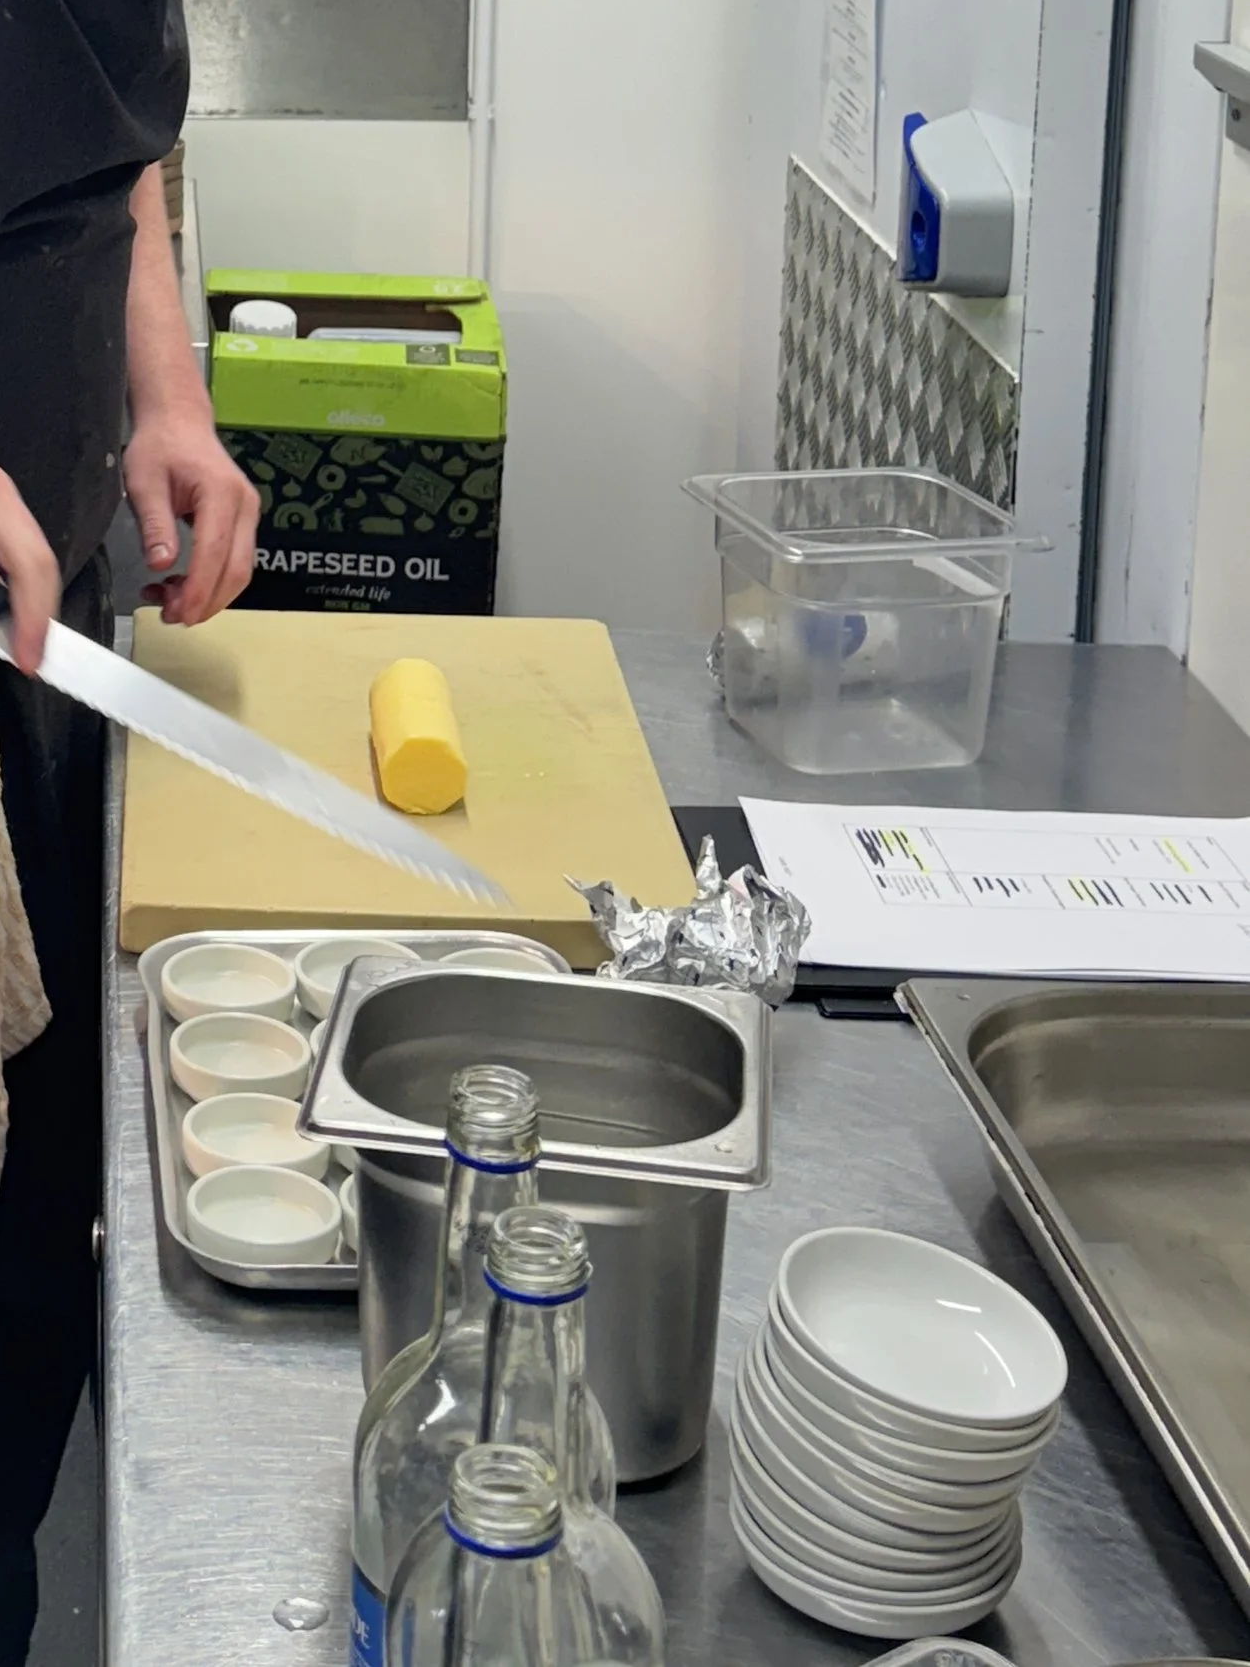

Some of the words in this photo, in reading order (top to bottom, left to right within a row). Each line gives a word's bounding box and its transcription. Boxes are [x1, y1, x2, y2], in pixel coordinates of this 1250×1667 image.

[254, 547, 396, 578] RAPESEED
[404, 557, 450, 581] OIL
[368, 585, 391, 602] life
